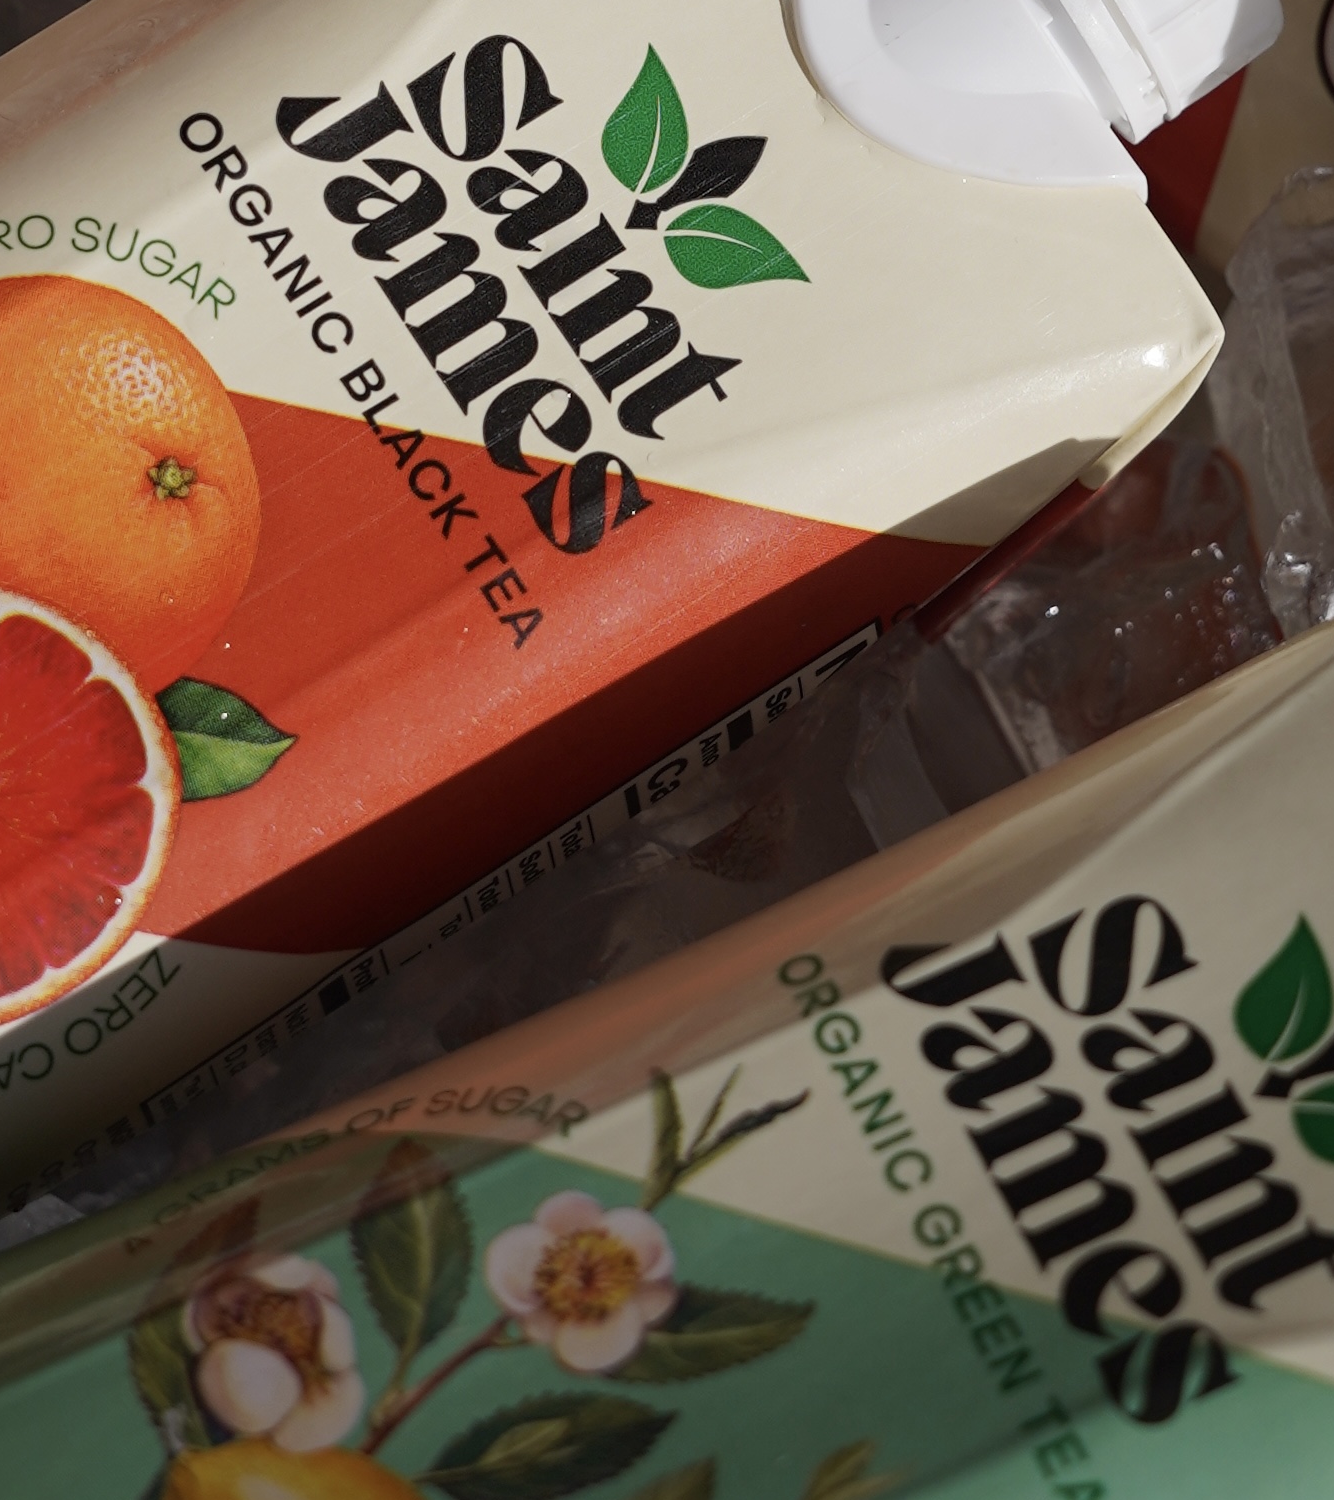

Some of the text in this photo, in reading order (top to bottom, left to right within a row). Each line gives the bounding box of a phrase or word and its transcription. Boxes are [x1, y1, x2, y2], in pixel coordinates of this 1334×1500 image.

[70, 216, 237, 321] SUGAR
[178, 112, 545, 651] ORGANIC BLACK TEA
[276, 80, 654, 555] James
[408, 34, 742, 442] Saint
[66, 948, 181, 1056] ZERO
[346, 1096, 420, 1136] OF
[423, 1085, 591, 1141] SUGAR
[778, 953, 933, 1196] ORGANIC
[912, 1202, 1043, 1395] GREEN
[879, 931, 1242, 1426] James
